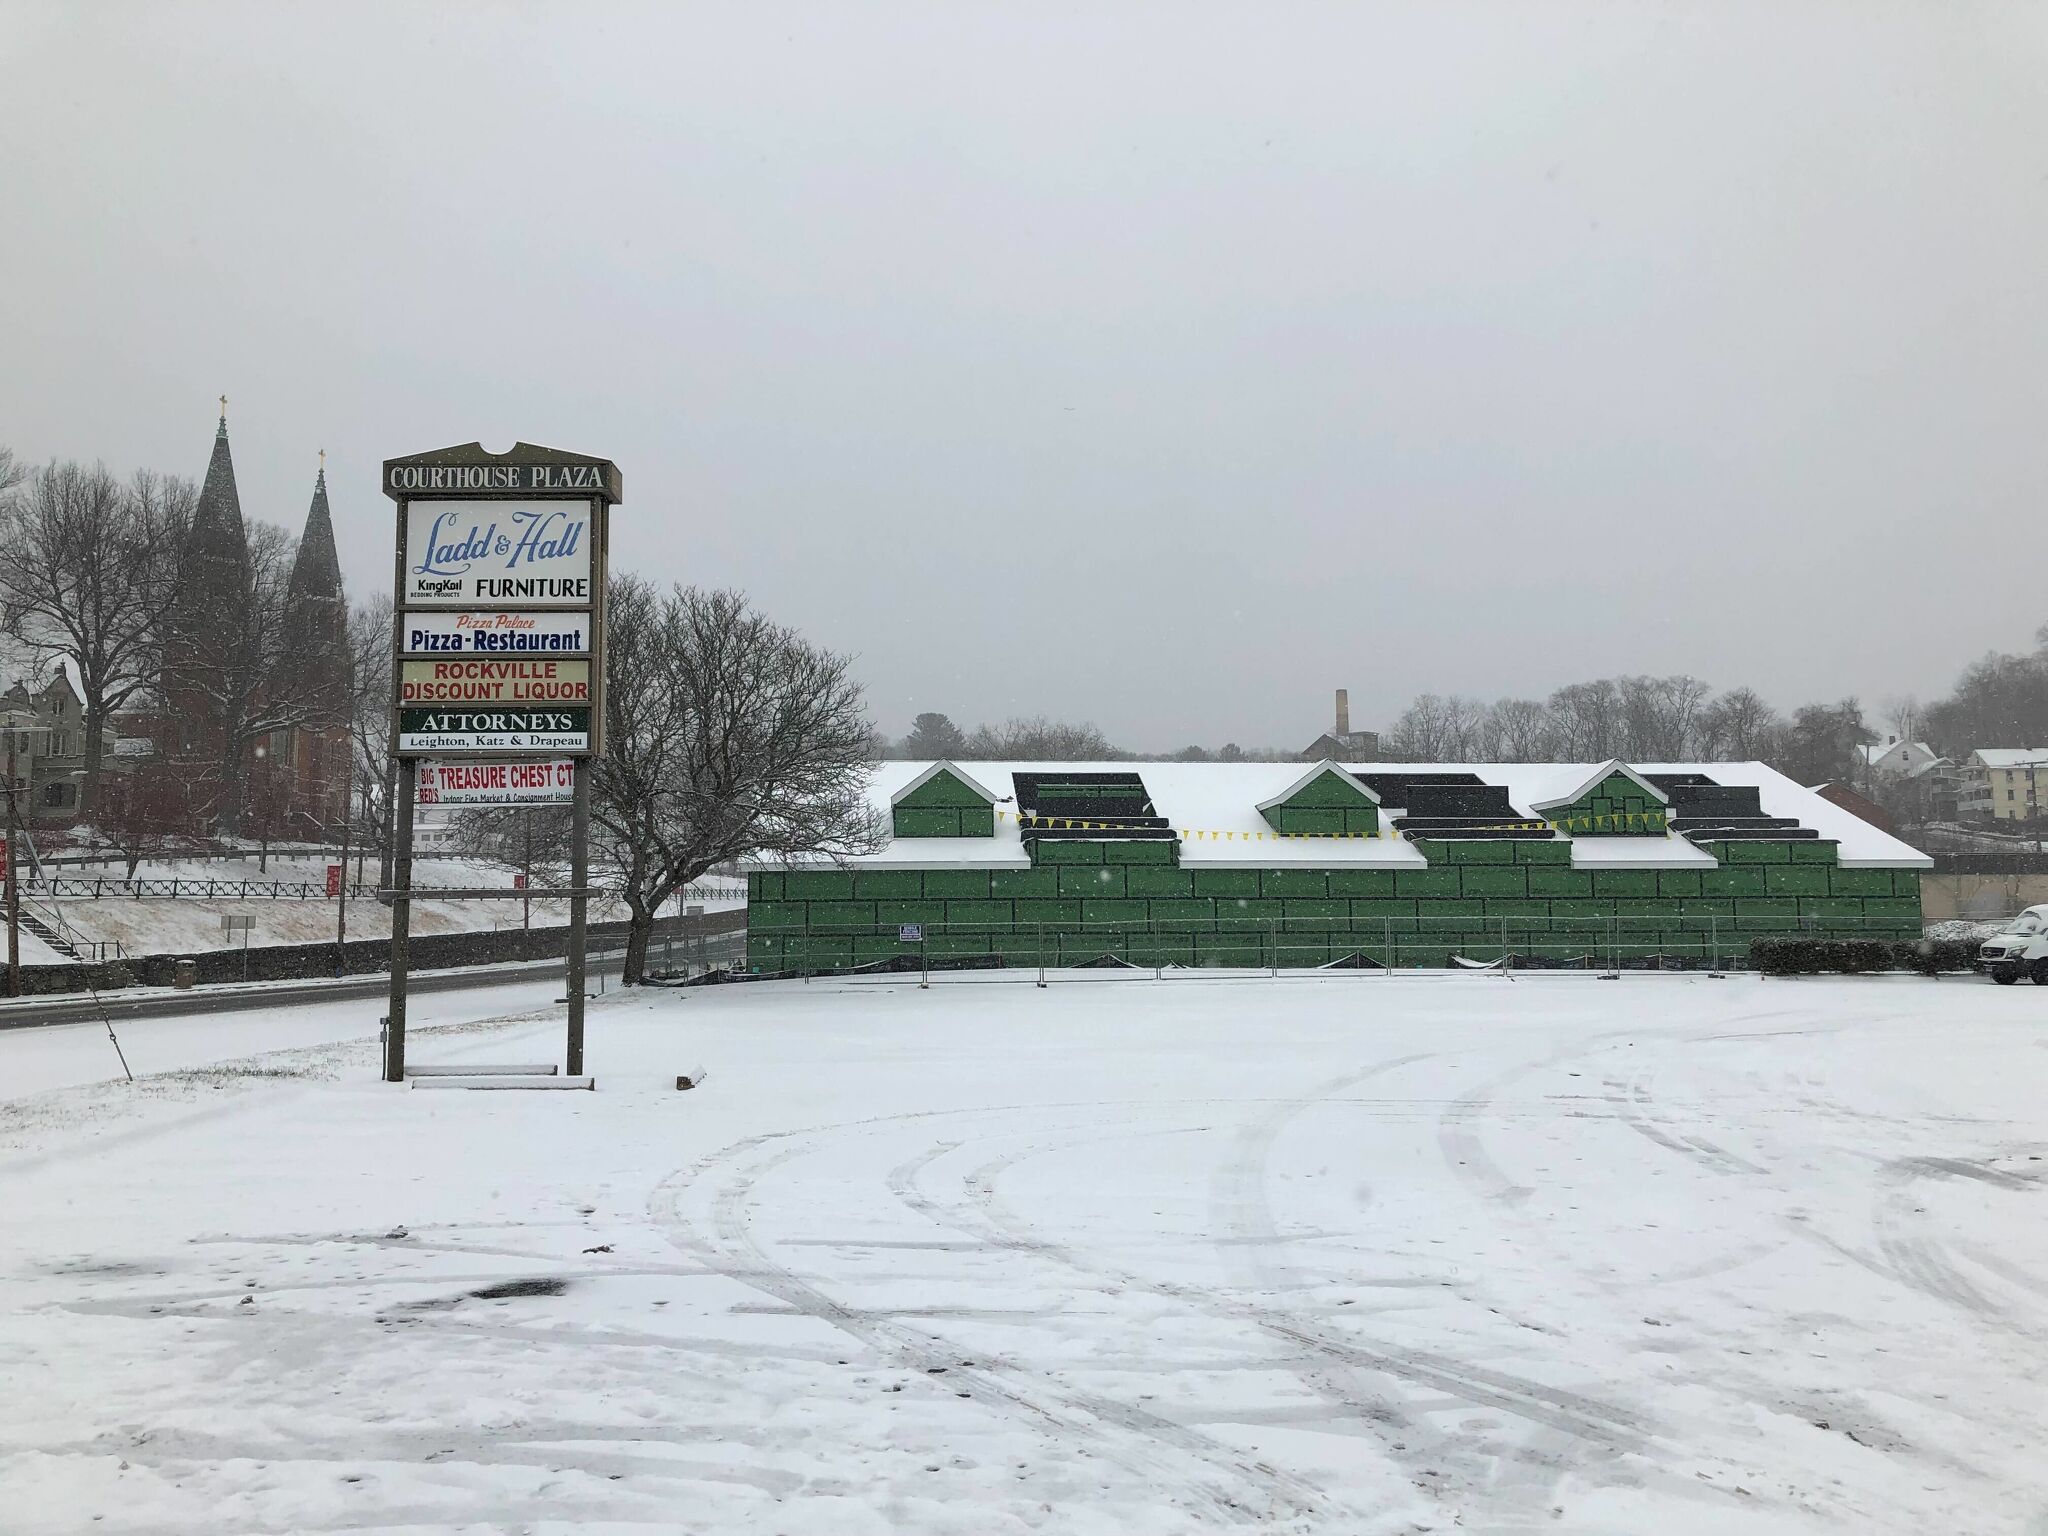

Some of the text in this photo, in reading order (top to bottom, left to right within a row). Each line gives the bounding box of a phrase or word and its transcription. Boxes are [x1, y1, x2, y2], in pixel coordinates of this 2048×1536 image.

[390, 466, 604, 488] COURTHOUSE PLAZA
[412, 511, 584, 576] Ladd & Hall
[476, 579, 588, 598] FURNITURE
[456, 614, 535, 629] Pizza Palace
[434, 662, 557, 679] ROCKVILLE
[403, 682, 588, 700] DISCOUNT LIQUOR
[421, 713, 573, 731] ATTORNEYS
[410, 735, 582, 749] Leighton, Katz & Drapeau
[421, 768, 434, 785] BIG
[438, 766, 507, 790] TREASURE
[511, 764, 552, 789] CHEST
[419, 788, 439, 804] RED'S
[443, 795, 463, 803] Indoor
[465, 794, 478, 802] Flea
[480, 793, 503, 802] Market
[505, 793, 511, 801] &
[513, 792, 554, 804] Consignment
